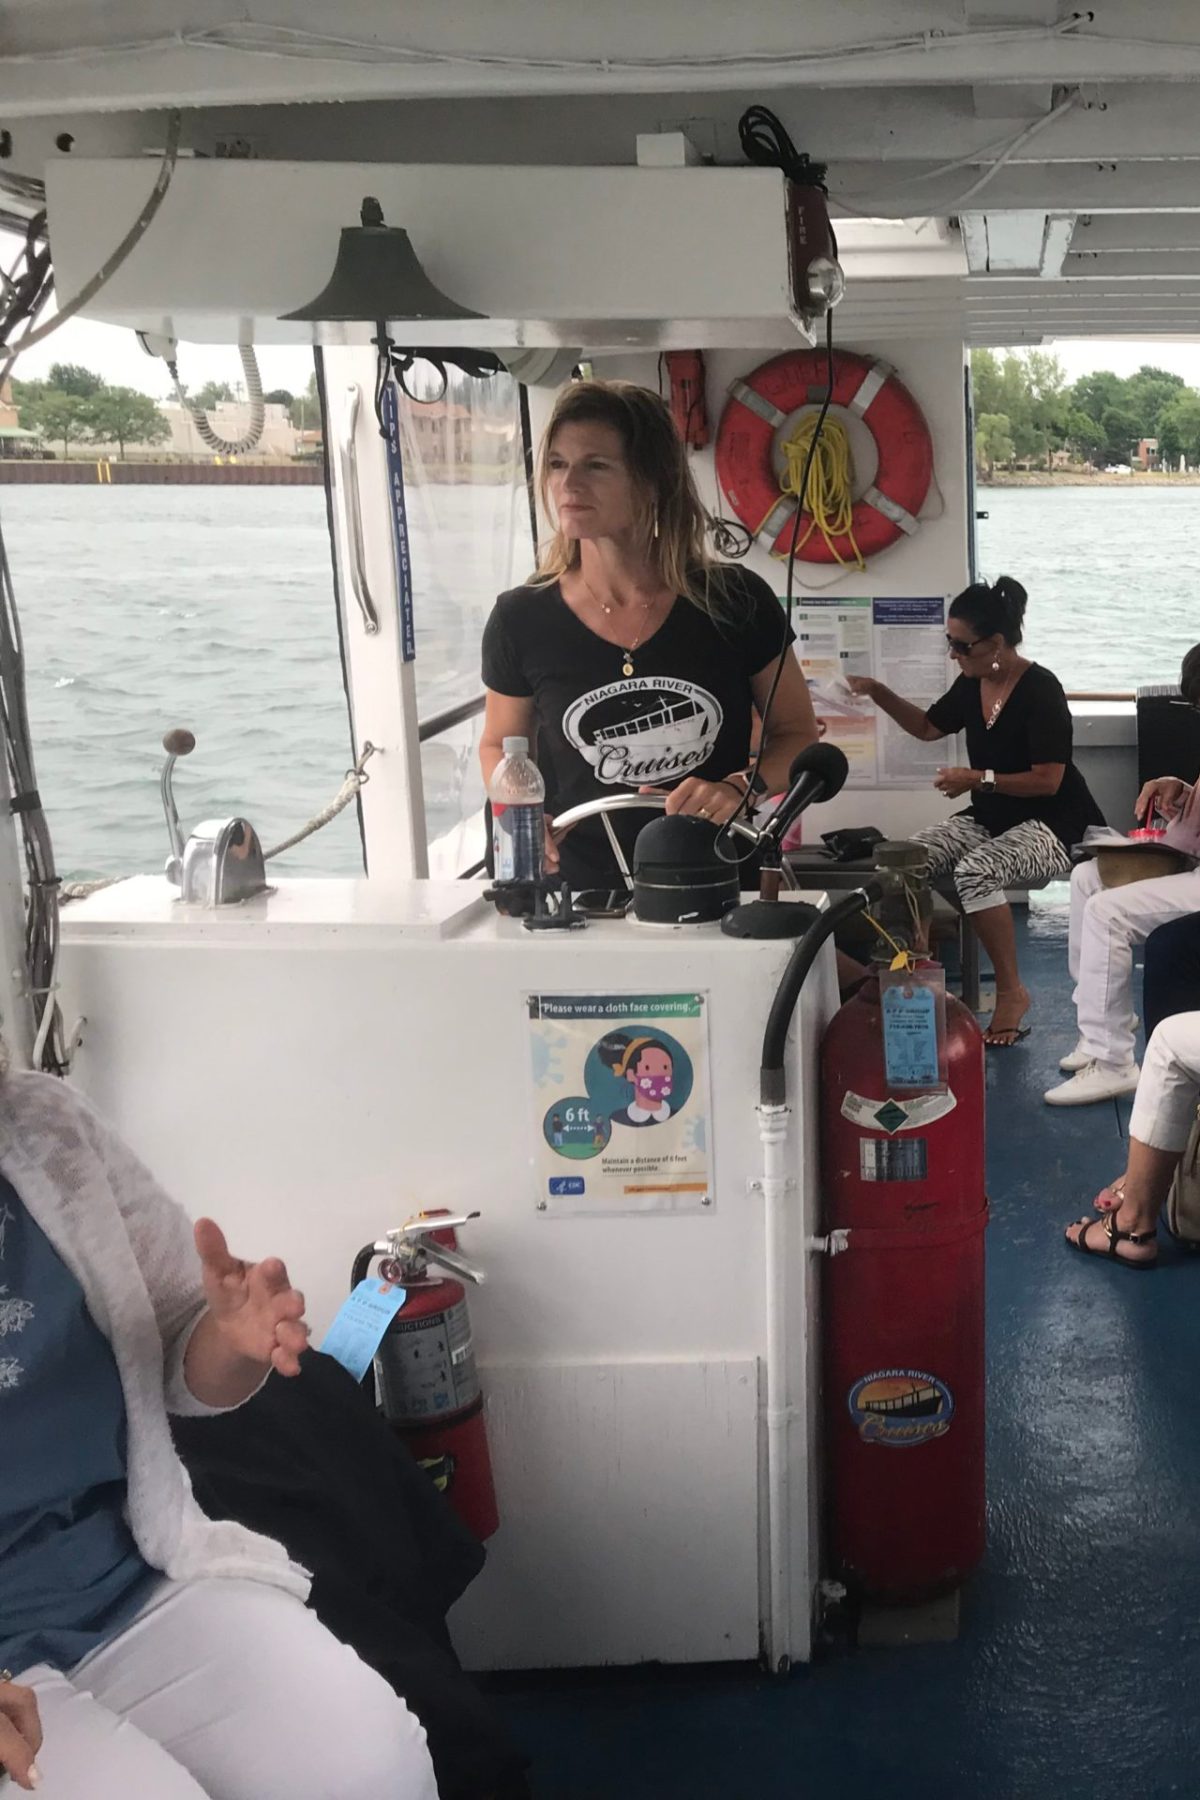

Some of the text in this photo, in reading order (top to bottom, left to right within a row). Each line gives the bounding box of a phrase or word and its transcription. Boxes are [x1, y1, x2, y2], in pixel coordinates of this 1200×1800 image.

[386, 385, 413, 655] TIPS APPRECIATED
[584, 679, 694, 706] NIAGARA RIVER
[598, 743, 712, 780] Cruises
[543, 1002, 691, 1014] Please wear a cloth face covering.
[565, 1108, 590, 1122] 6 ft
[636, 1156, 661, 1164] distance
[662, 1155, 669, 1163] of
[863, 1370, 936, 1383] NIAGARA RIVER
